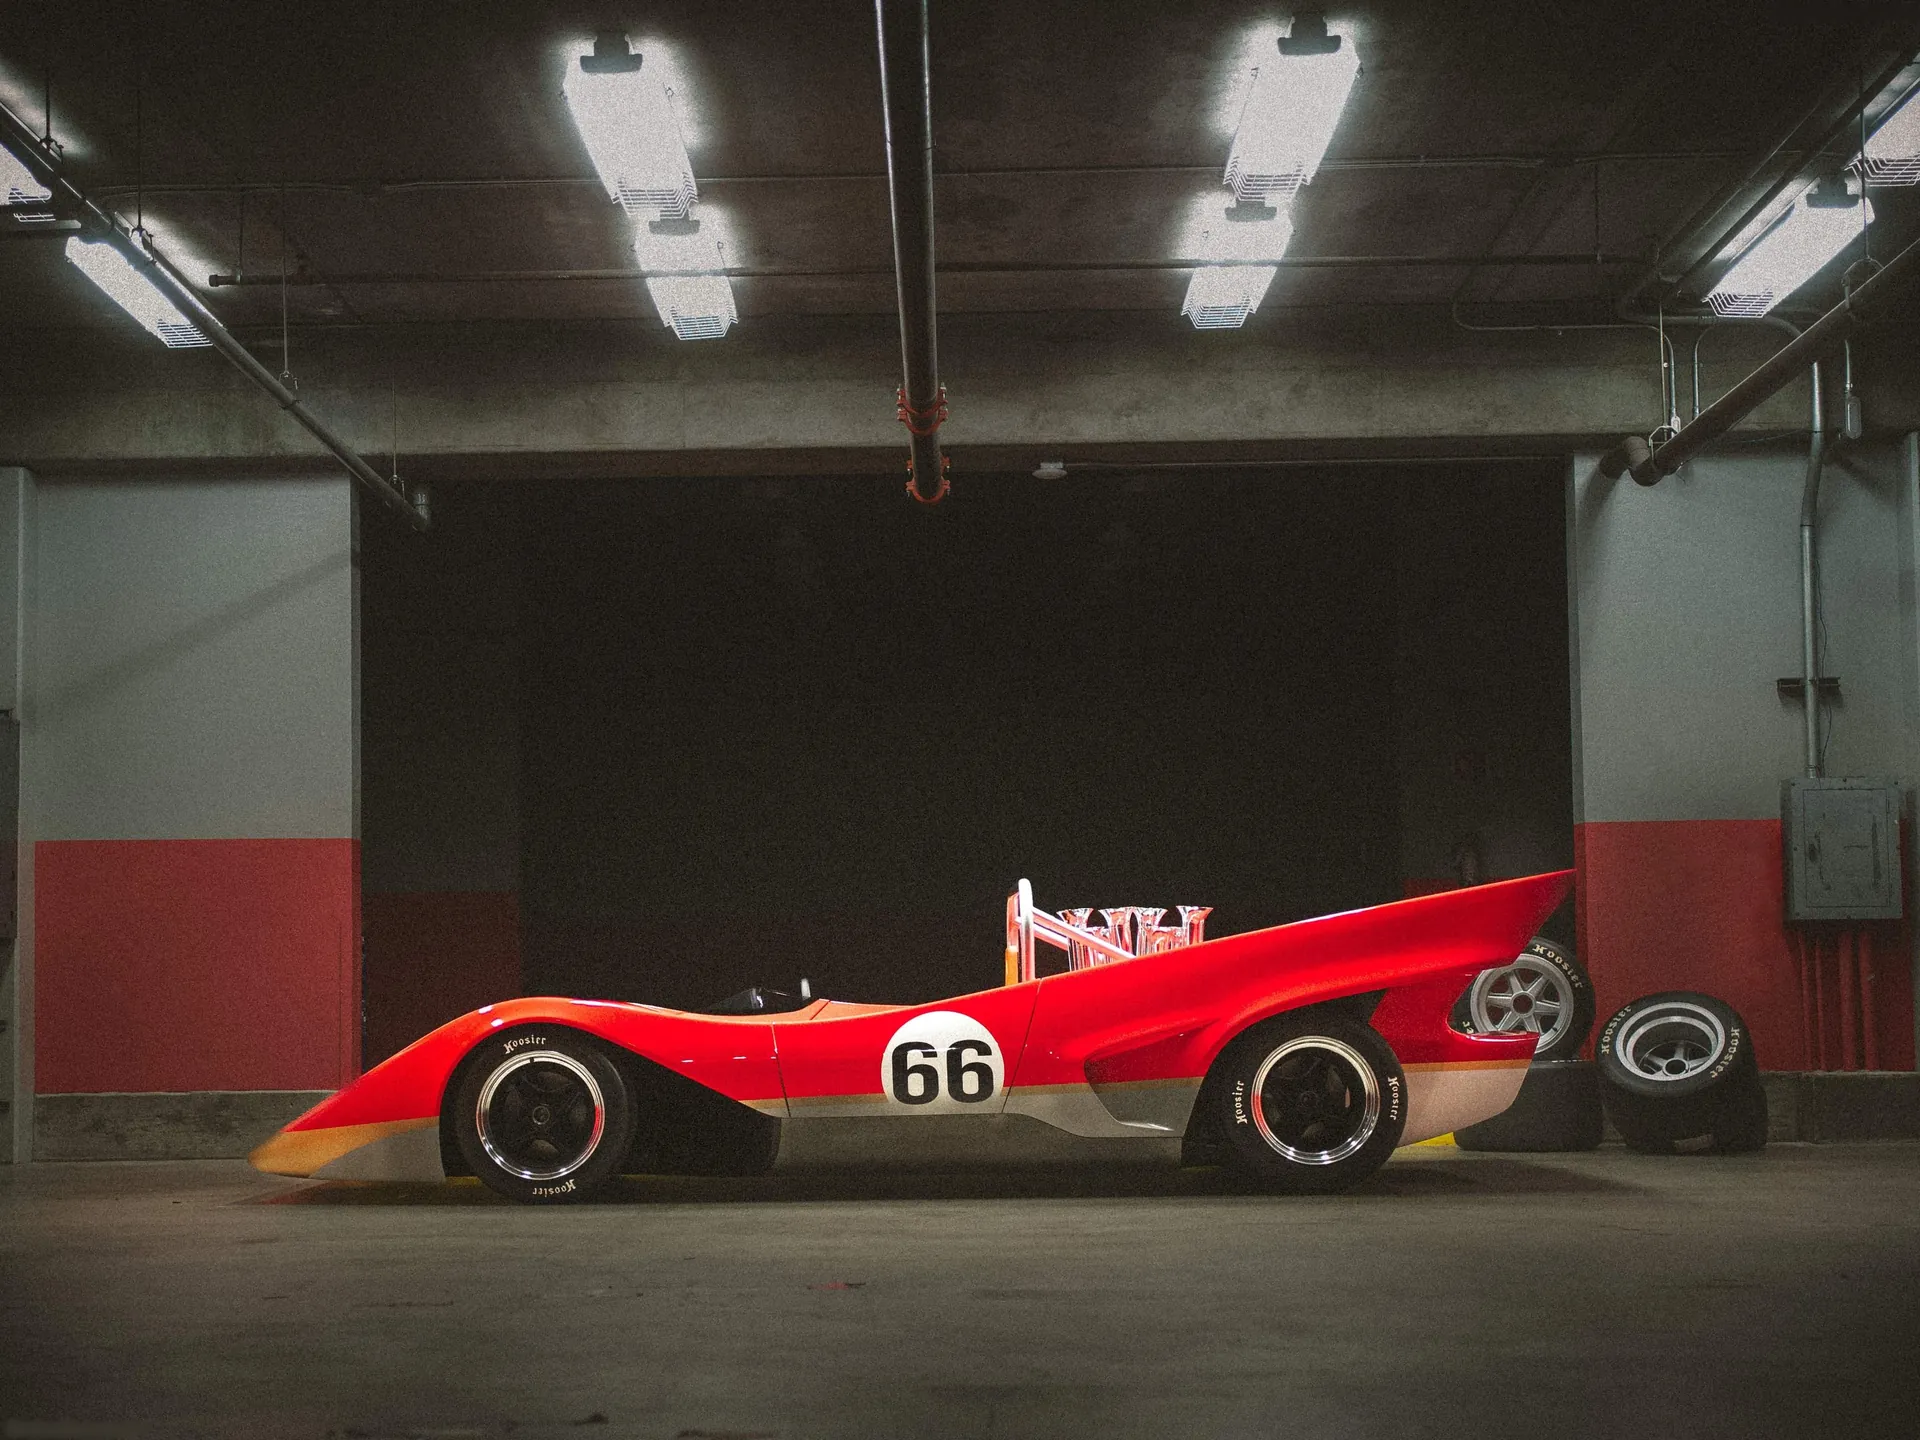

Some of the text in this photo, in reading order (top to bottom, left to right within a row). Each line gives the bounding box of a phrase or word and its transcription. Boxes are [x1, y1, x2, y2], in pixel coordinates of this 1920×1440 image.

[1532, 944, 1583, 988] Hoosier
[503, 1034, 547, 1055] Hoosier
[1601, 1005, 1632, 1055] Hoosier
[1710, 1026, 1740, 1078] Hoosier
[891, 1039, 995, 1106] 66
[1231, 1080, 1248, 1124] Hoosier
[1387, 1076, 1400, 1121] Hoosier
[532, 1179, 577, 1198] Hoosier
